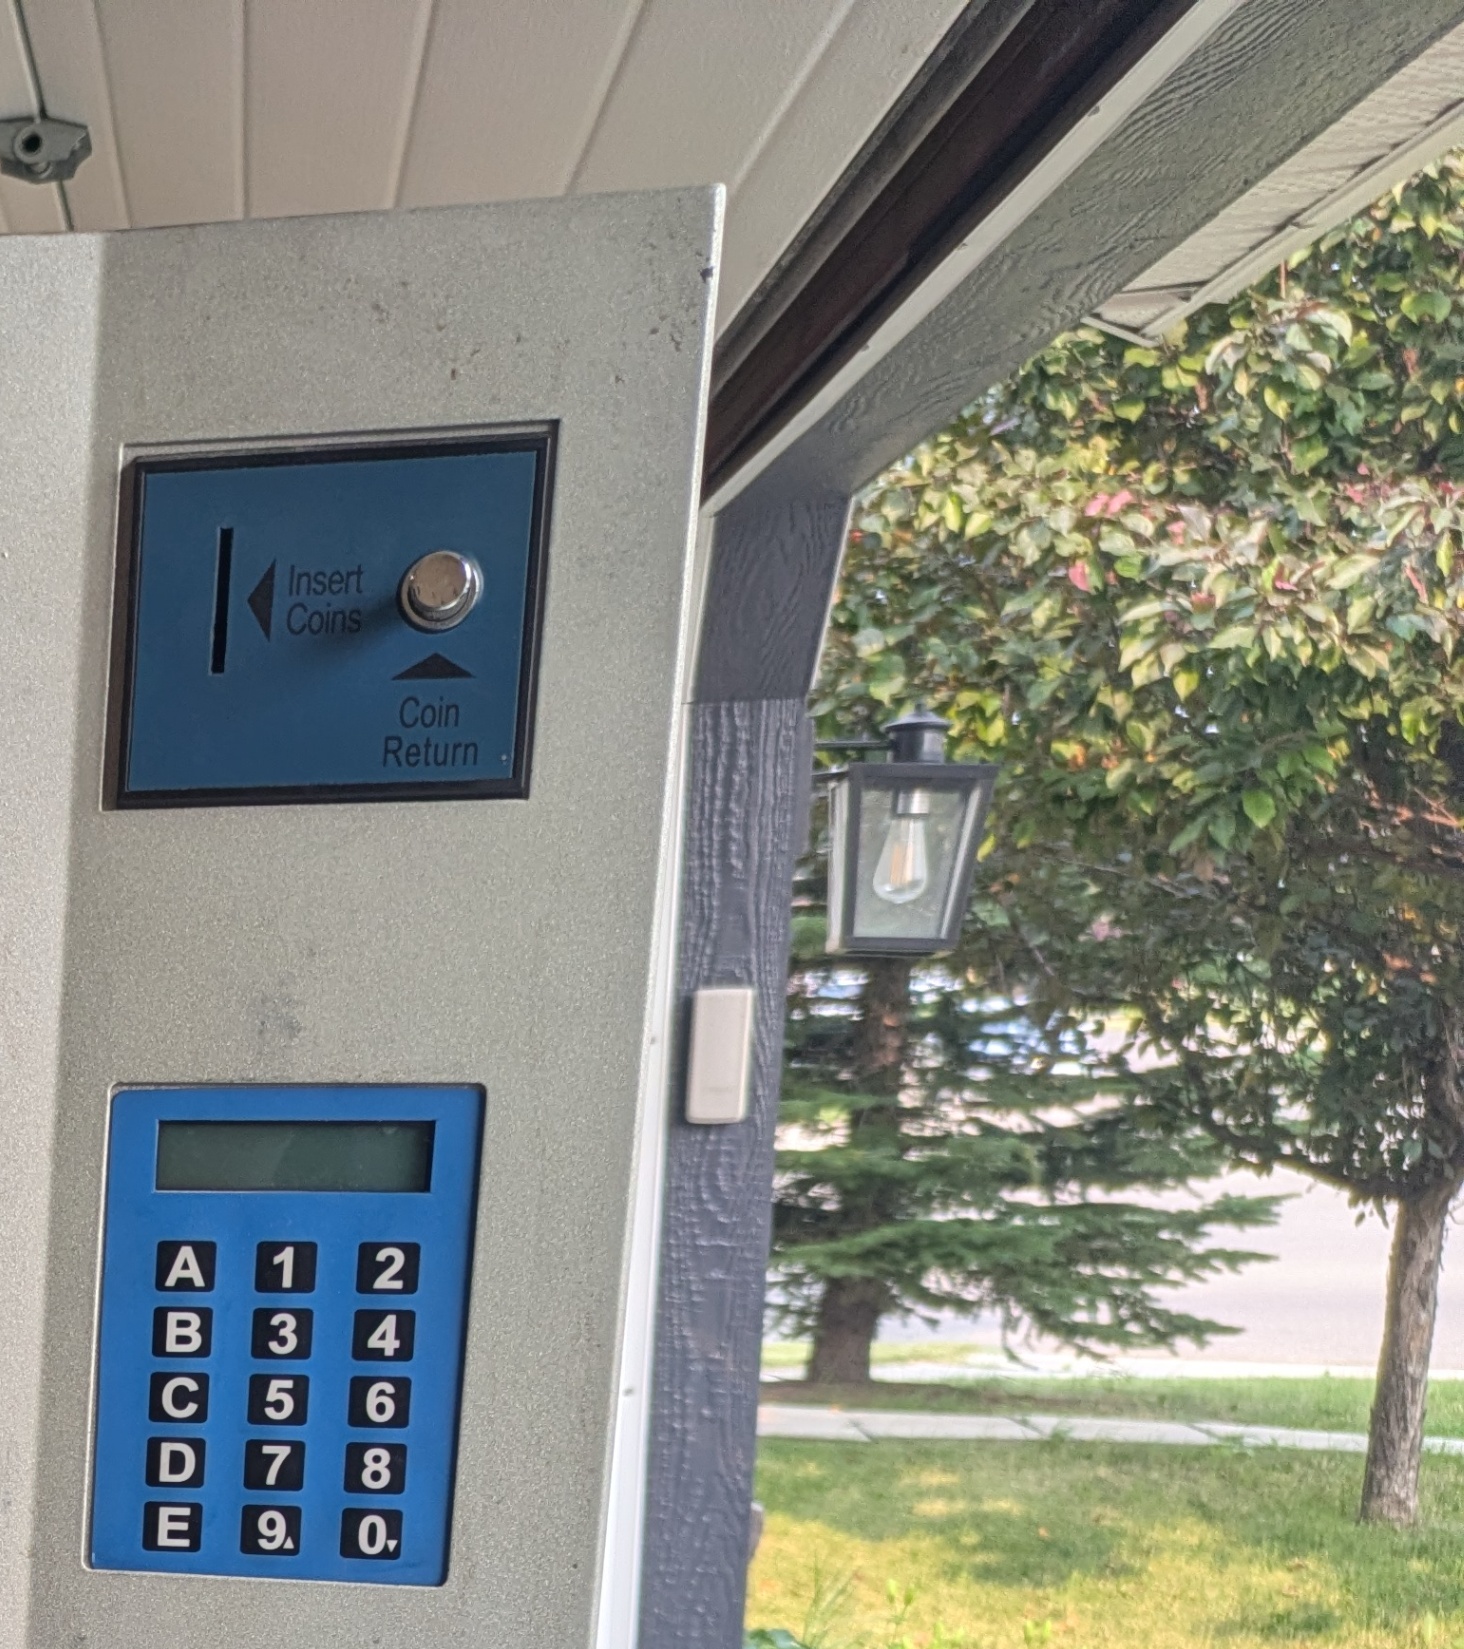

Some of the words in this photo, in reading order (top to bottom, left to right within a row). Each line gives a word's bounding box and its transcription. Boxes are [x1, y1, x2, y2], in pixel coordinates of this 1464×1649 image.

[288, 564, 363, 596] Insert
[286, 604, 362, 636] Coins
[399, 697, 460, 729] Coin
[383, 736, 479, 768] Return
[165, 1246, 205, 1288] A
[272, 1247, 295, 1288] 1
[373, 1248, 405, 1290] 2
[165, 1312, 202, 1353] B
[268, 1314, 297, 1355] 3
[367, 1315, 400, 1357] 4
[161, 1377, 199, 1419] C
[264, 1379, 294, 1420] 5
[366, 1381, 396, 1423] 6
[159, 1442, 196, 1483] D
[261, 1445, 291, 1485] 7
[361, 1447, 391, 1489] 8
[157, 1507, 191, 1547] E
[257, 1510, 286, 1551] 9
[358, 1514, 387, 1555] 0
